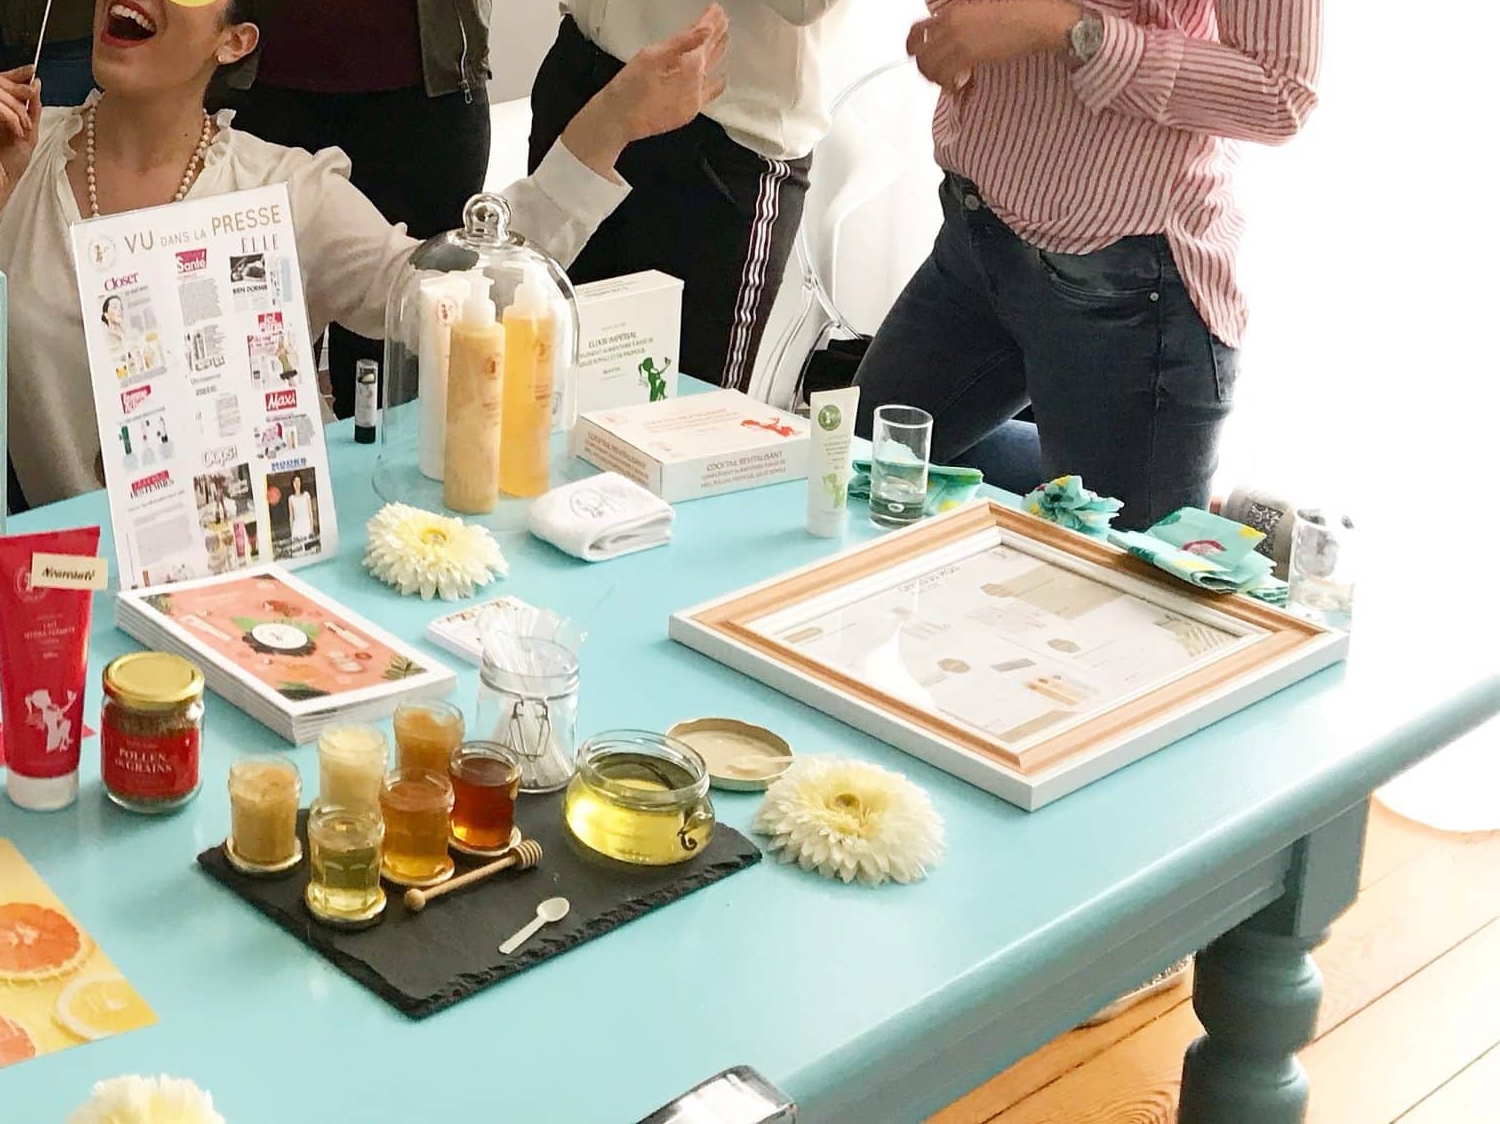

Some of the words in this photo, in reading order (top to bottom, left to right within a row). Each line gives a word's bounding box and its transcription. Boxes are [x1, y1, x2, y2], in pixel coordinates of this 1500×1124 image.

[124, 230, 154, 254] VU
[160, 230, 190, 248] DANS
[193, 230, 207, 241] LA
[211, 205, 282, 237] PRESSE
[241, 234, 279, 253] ELLE
[104, 272, 139, 292] Closer
[266, 392, 296, 411] Maxi
[119, 747, 166, 762] POLLEN
[126, 760, 172, 773] GRAINS
